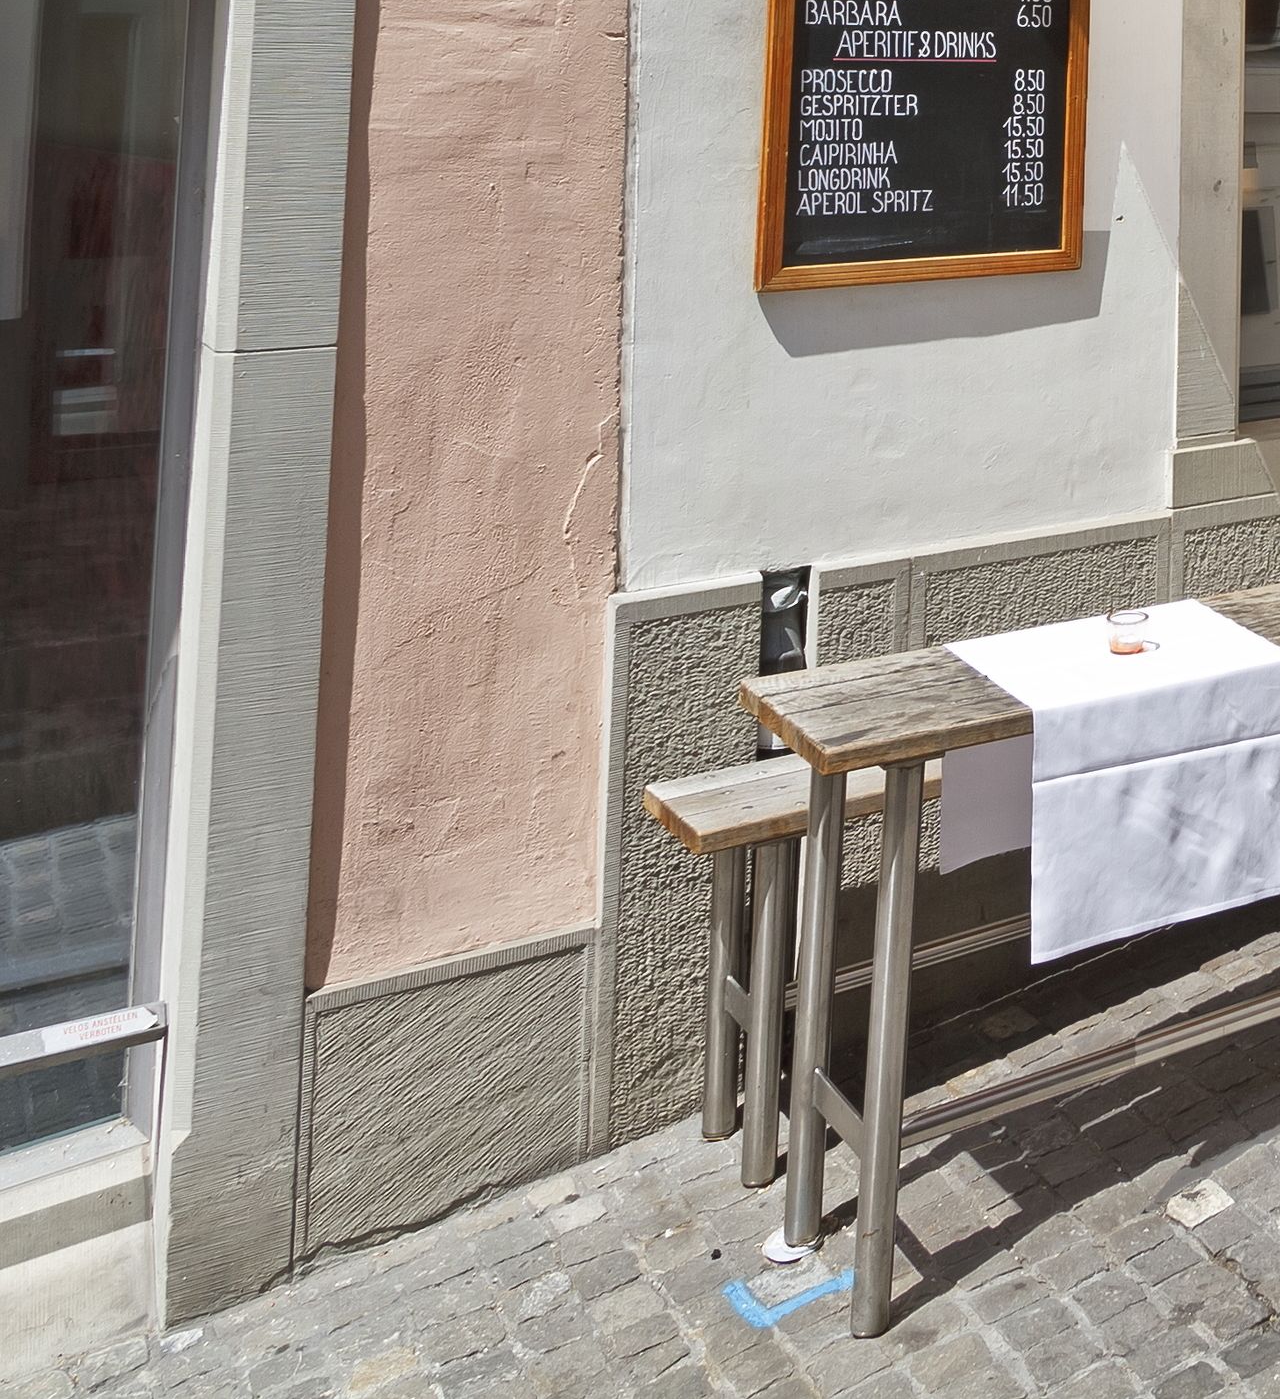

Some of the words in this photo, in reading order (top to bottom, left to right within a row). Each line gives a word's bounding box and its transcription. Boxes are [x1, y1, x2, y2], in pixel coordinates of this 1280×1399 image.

[805, 0, 902, 26] BARBARA
[1017, 4, 1052, 28] 6.50
[934, 31, 997, 58] DRINKS
[800, 69, 892, 93] PROSECCO
[1014, 68, 1045, 92] 8.50
[800, 94, 919, 117] GESPRITZTER
[1013, 93, 1045, 115] 8.50
[800, 118, 863, 141] MOJITO
[1002, 116, 1045, 137] 15.50
[800, 140, 898, 166] CAIPIRINHA
[1003, 138, 1044, 159] 15.50
[798, 167, 891, 191] LONGDRINK
[1002, 161, 1044, 182] 15.50
[796, 190, 867, 216] APEROL
[871, 189, 934, 213] SPRITZ
[1002, 182, 1044, 207] 11.50
[63, 1024, 89, 1035] VELOS
[92, 1011, 138, 1028] ANSTELLEN
[80, 1024, 122, 1041] VERBOTEN
